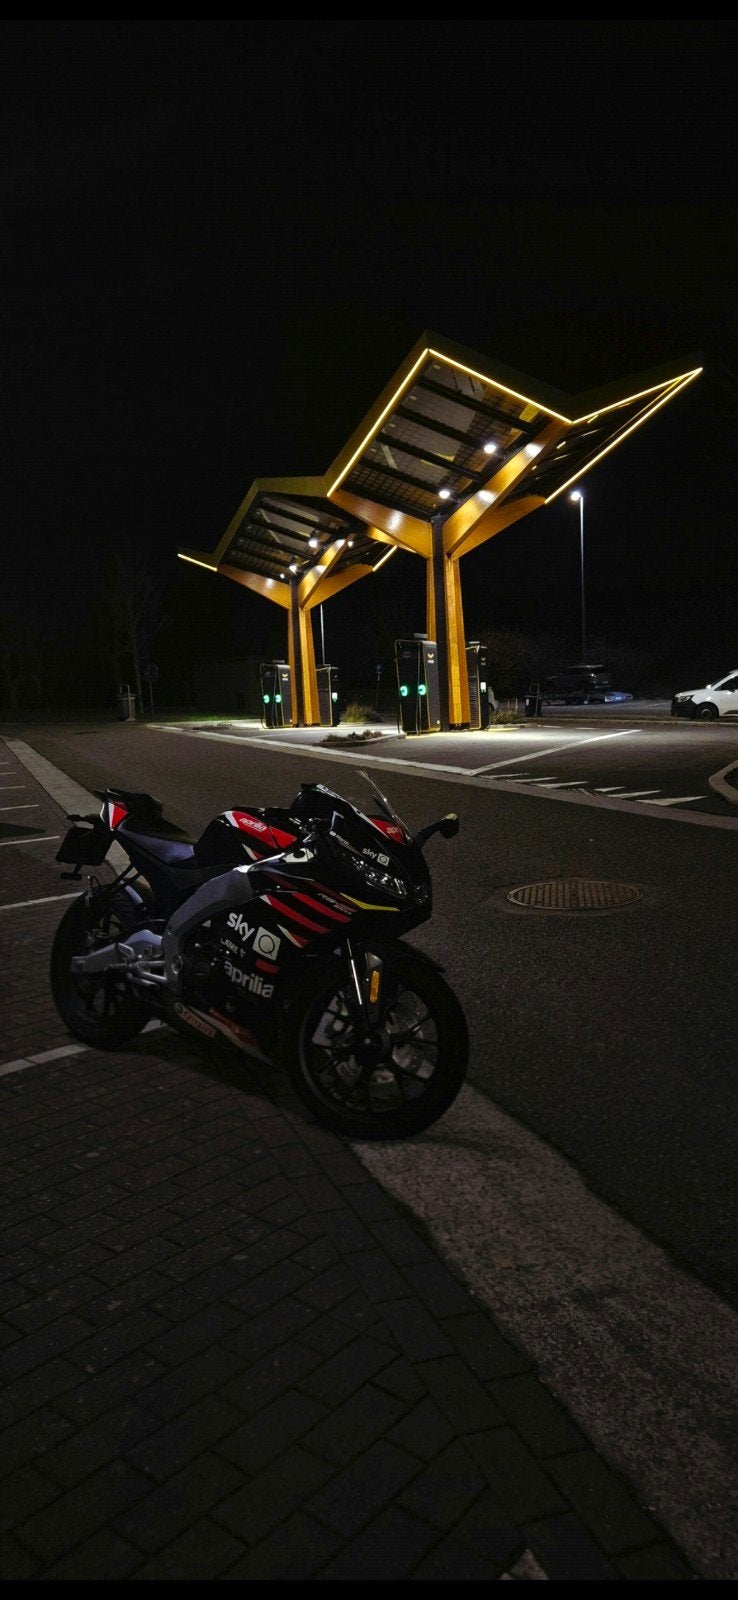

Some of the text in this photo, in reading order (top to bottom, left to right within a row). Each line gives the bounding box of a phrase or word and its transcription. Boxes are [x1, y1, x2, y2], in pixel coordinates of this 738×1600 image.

[362, 847, 378, 859] sky
[226, 912, 255, 942] sky
[223, 960, 274, 999] aprilia
